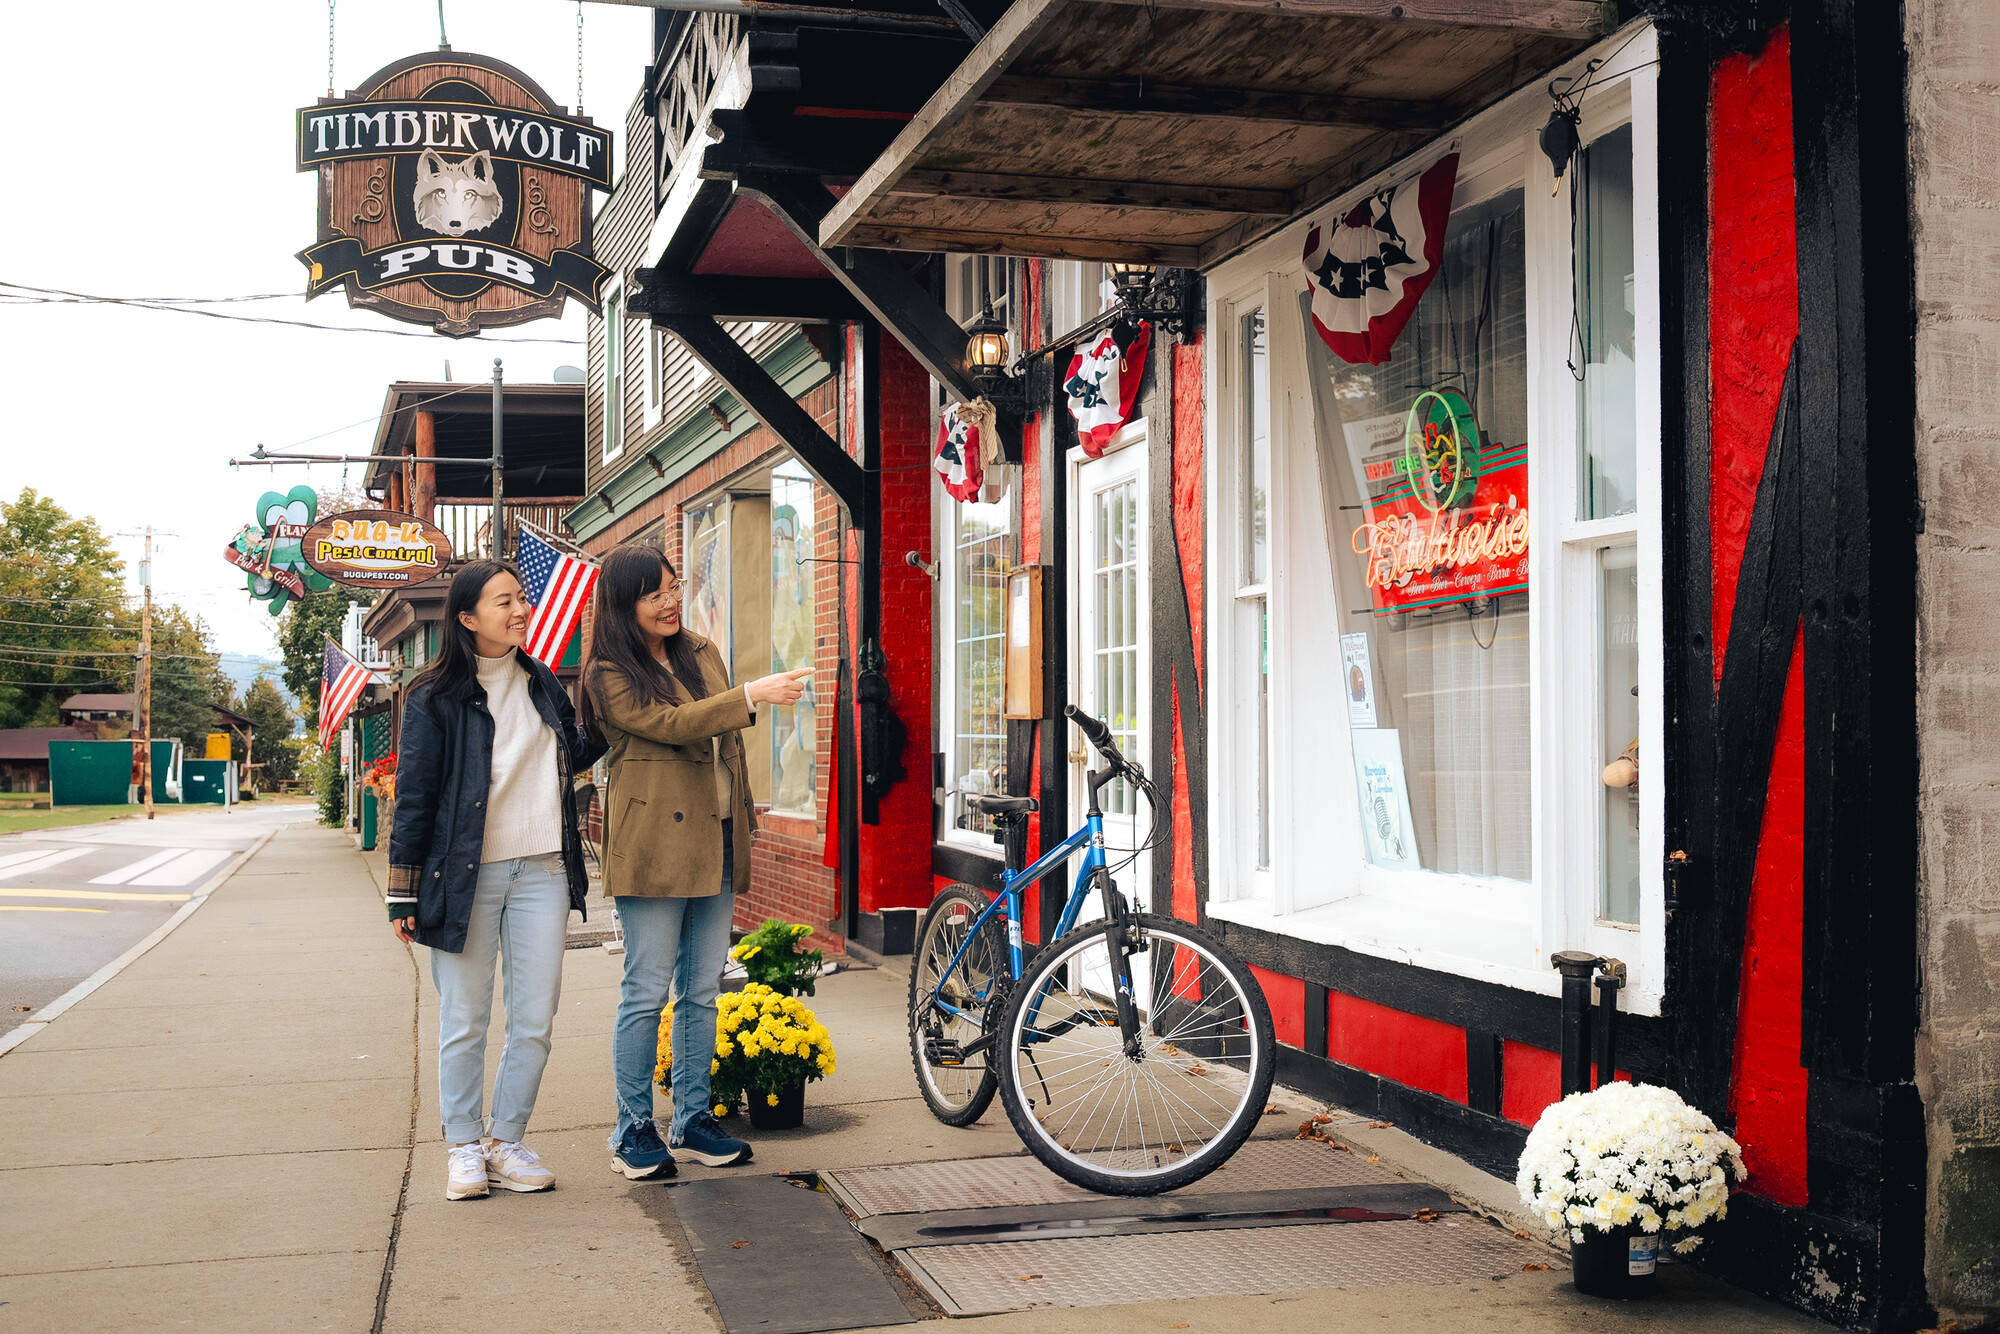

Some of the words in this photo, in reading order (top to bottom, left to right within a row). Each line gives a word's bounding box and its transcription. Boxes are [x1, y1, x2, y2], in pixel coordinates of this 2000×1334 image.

[310, 111, 601, 169] TIMBERWOLF
[380, 245, 536, 285] PUB
[333, 521, 420, 543] BUG-U
[317, 541, 361, 560] Pest
[363, 546, 436, 565] Control
[234, 556, 253, 569] Pub
[274, 571, 297, 588] Grill
[343, 571, 408, 580] BUGUPEST.COM
[1407, 581, 1425, 596] Beer
[1453, 571, 1481, 590] Cerveza
[1487, 564, 1510, 582] Birra
